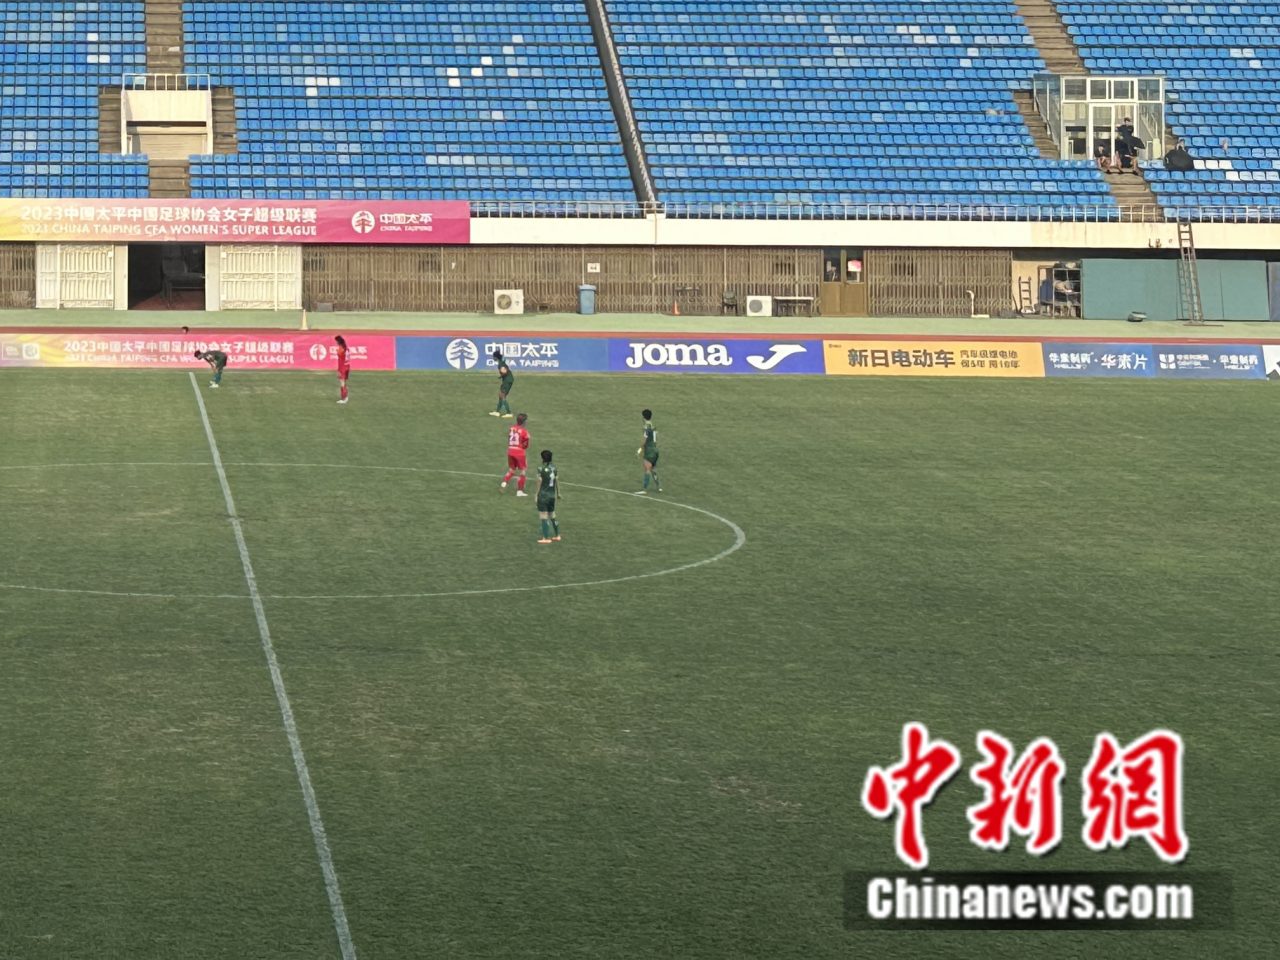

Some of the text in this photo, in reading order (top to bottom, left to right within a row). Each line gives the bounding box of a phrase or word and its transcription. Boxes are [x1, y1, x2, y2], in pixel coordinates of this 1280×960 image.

[93, 224, 141, 235] TAIPING
[232, 225, 269, 235] SUPER
[272, 225, 317, 236] LEAGUE
[485, 342, 559, 358] 中国太平
[847, 348, 956, 368] 新日电动车
